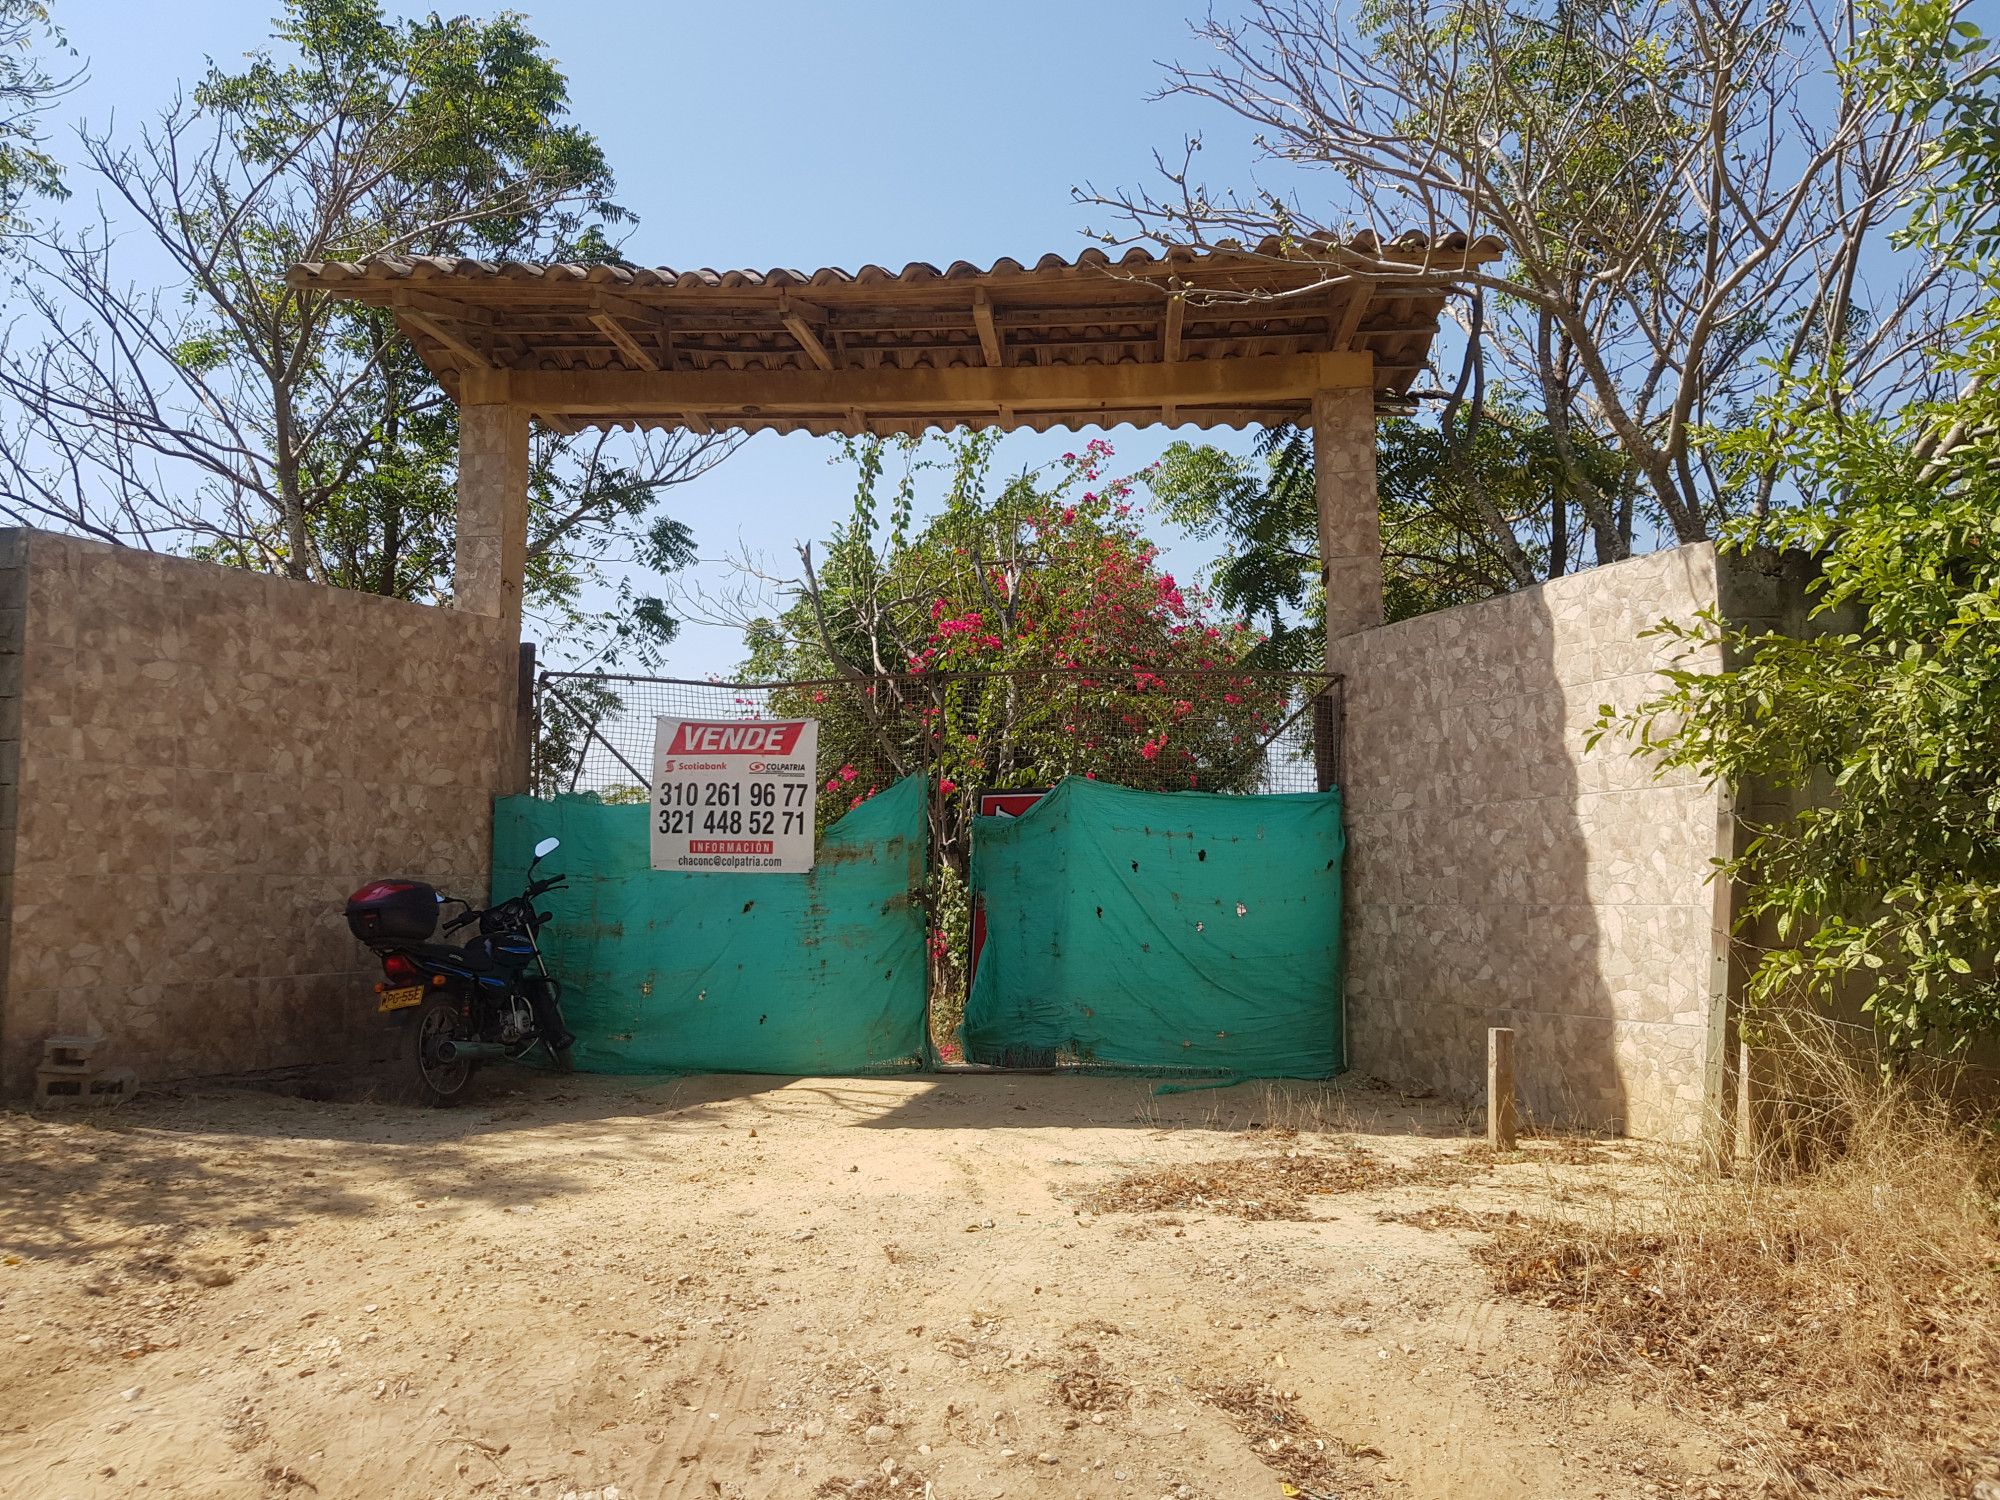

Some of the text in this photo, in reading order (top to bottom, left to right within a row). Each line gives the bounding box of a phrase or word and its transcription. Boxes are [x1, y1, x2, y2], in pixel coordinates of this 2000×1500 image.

[684, 726, 786, 751] VENDE
[678, 762, 727, 771] Scotiabank
[766, 763, 806, 771] COLPATRIA
[659, 782, 808, 807] 310 261 96 77
[658, 810, 804, 835] 321 448 52 71
[693, 842, 770, 853] INFORMACIÓN
[678, 856, 782, 868] chaconc@colpatria.com
